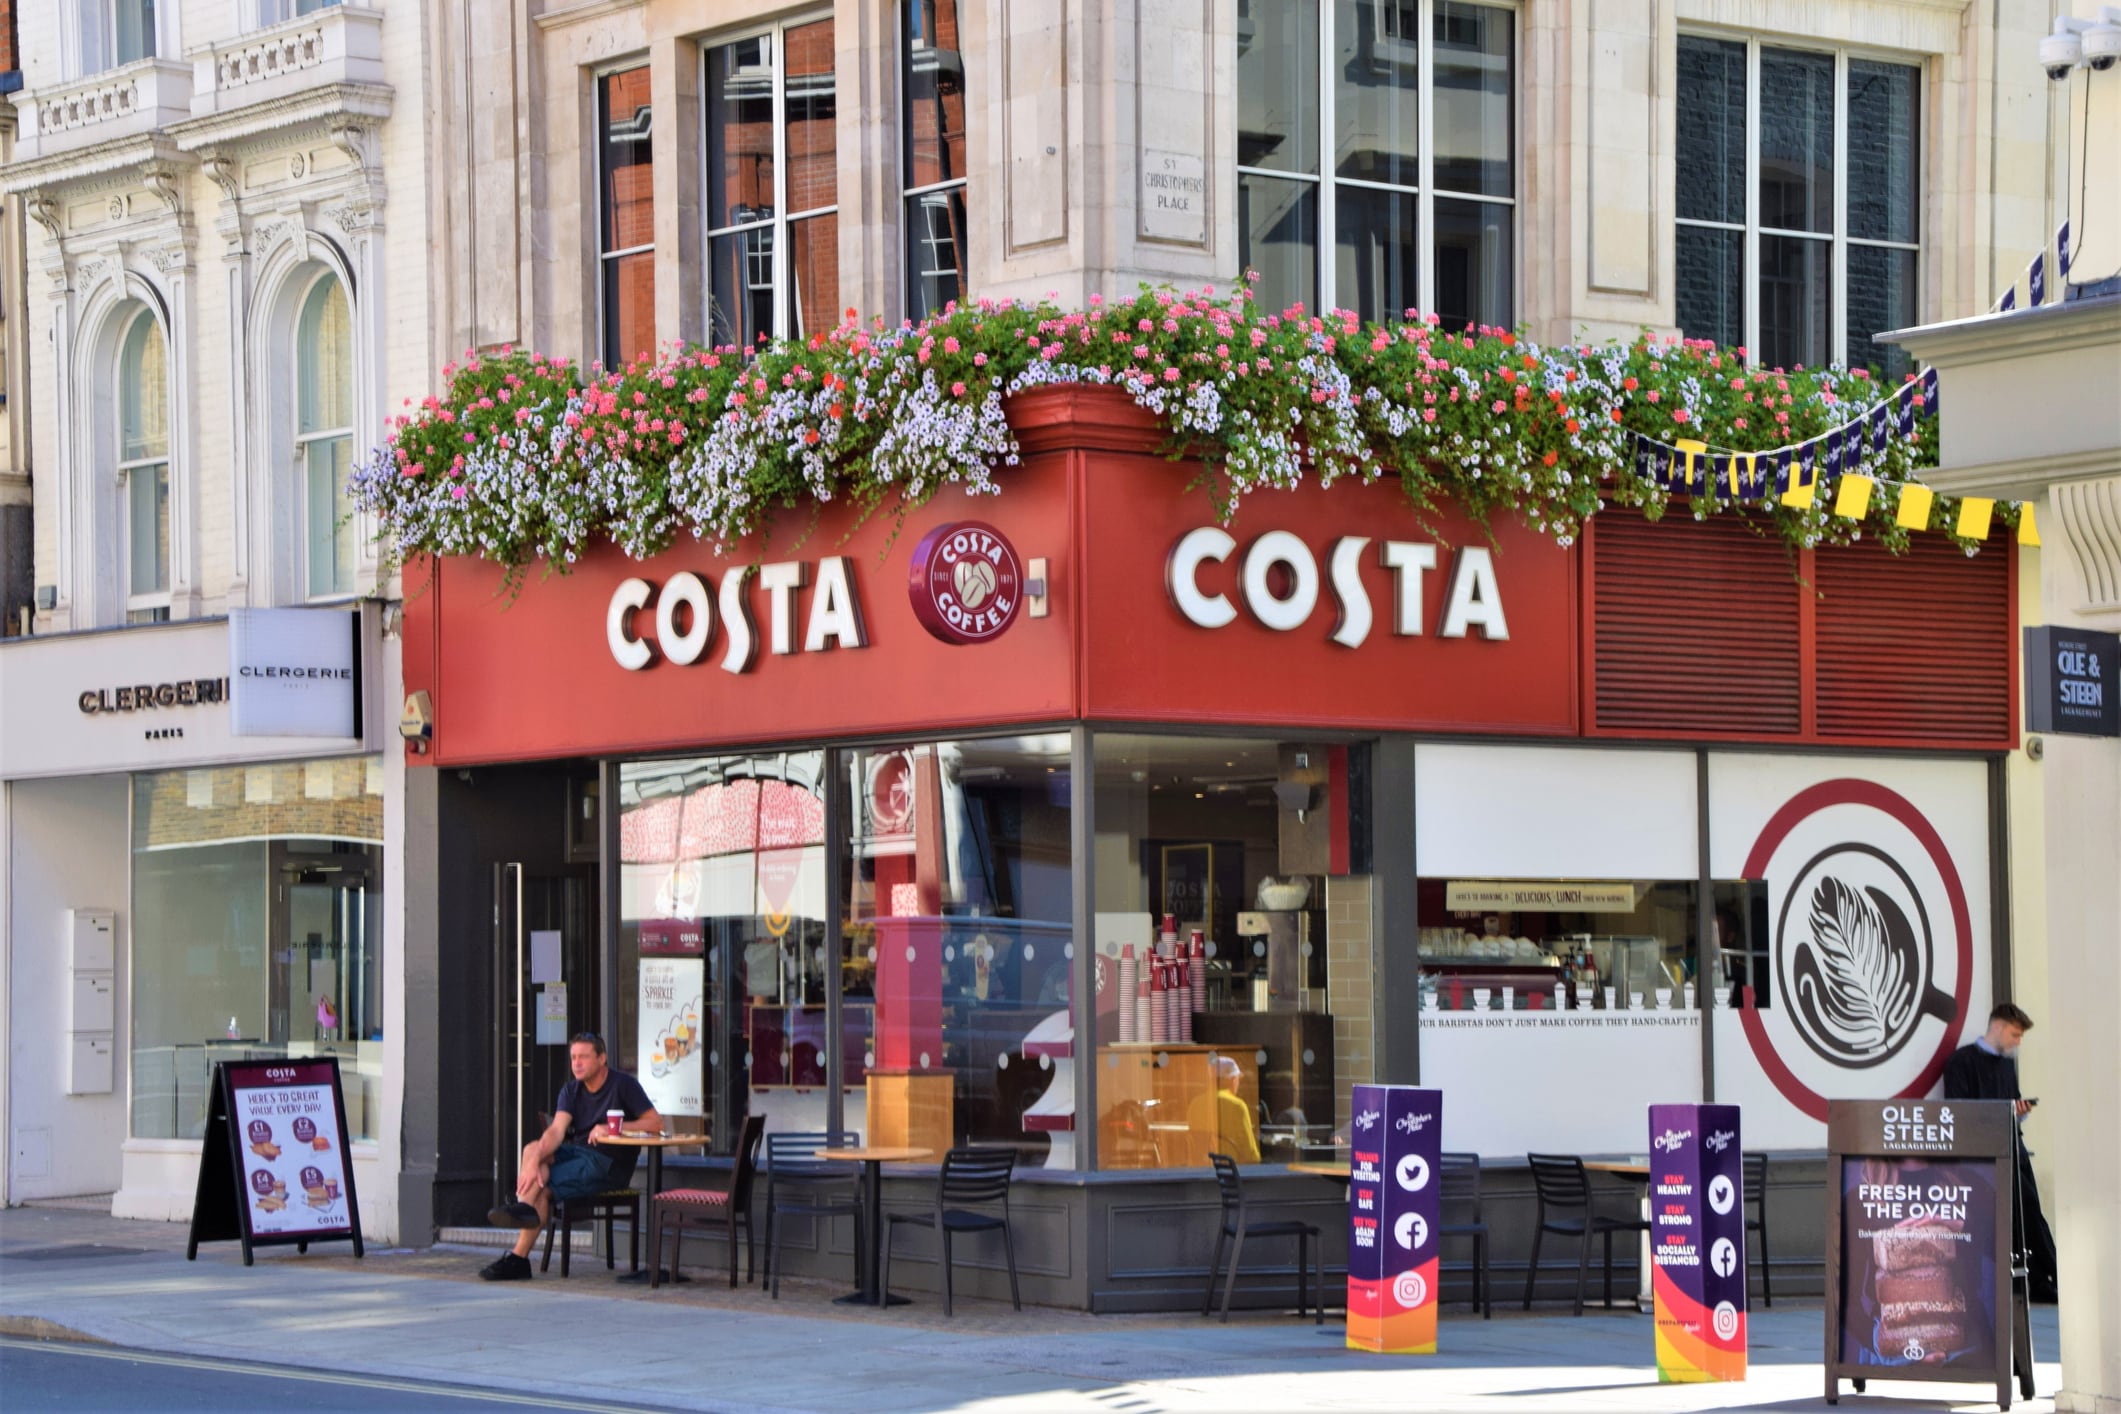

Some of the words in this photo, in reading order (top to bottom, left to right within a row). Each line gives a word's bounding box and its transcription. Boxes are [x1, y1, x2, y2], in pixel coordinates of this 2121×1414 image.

[1157, 194, 1190, 210] PLACE
[942, 532, 1003, 566] COSTA
[1165, 526, 1511, 649] COSTA
[606, 555, 868, 674] COSTA
[938, 592, 1011, 633] COFFEE
[2057, 650, 2086, 676] OLE
[2088, 653, 2101, 678] &
[239, 665, 352, 680] CLERGERIE
[2060, 679, 2103, 706] STEEN
[145, 727, 184, 740] PARIS
[1514, 890, 1552, 905] DELICIOUS
[1556, 890, 1581, 905] LUNCH
[644, 986, 673, 1000] SPARKLE
[1438, 1018, 1483, 1028] BARISTAS
[1485, 1018, 1513, 1028] DON'T
[1514, 1018, 1538, 1027] JUST
[1540, 1018, 1567, 1027] MAKE
[1568, 1017, 1603, 1027] COFFEE
[1605, 1017, 1629, 1027] THEY
[1631, 1016, 1688, 1027] HAND-CRAFT
[1689, 1016, 1699, 1026] IT
[265, 1067, 296, 1078] COSTA
[279, 1092, 289, 1103] TO
[290, 1091, 319, 1102] GREAT
[249, 1105, 273, 1116] VALUE
[277, 1104, 301, 1115] EVERY
[304, 1103, 322, 1114] DAY
[1882, 1105, 1924, 1124] OLE
[1939, 1105, 1955, 1124] &
[1883, 1124, 1954, 1142] STEEN
[1360, 1161, 1373, 1171] FOR
[1352, 1170, 1381, 1182] VISITING
[1664, 1174, 1684, 1185] STAY
[1358, 1189, 1374, 1200] STAY
[1657, 1184, 1692, 1195] HEALTHY
[1858, 1184, 1921, 1201] FRESH
[1928, 1185, 1973, 1203] OUT
[1358, 1199, 1373, 1210] SAFE
[1665, 1204, 1685, 1215] STAY
[1862, 1202, 1903, 1219] THE
[1909, 1203, 1967, 1221] OVEN
[317, 1215, 345, 1225] COSTA
[1658, 1214, 1692, 1226] STRONG
[1355, 1227, 1375, 1238] AGAIN
[1938, 1232, 1972, 1243] morning
[1356, 1236, 1374, 1248] SOON
[1666, 1235, 1686, 1245] STAY
[1657, 1245, 1697, 1256] SOCIALLY
[1654, 1254, 1700, 1266] DISTANCED
